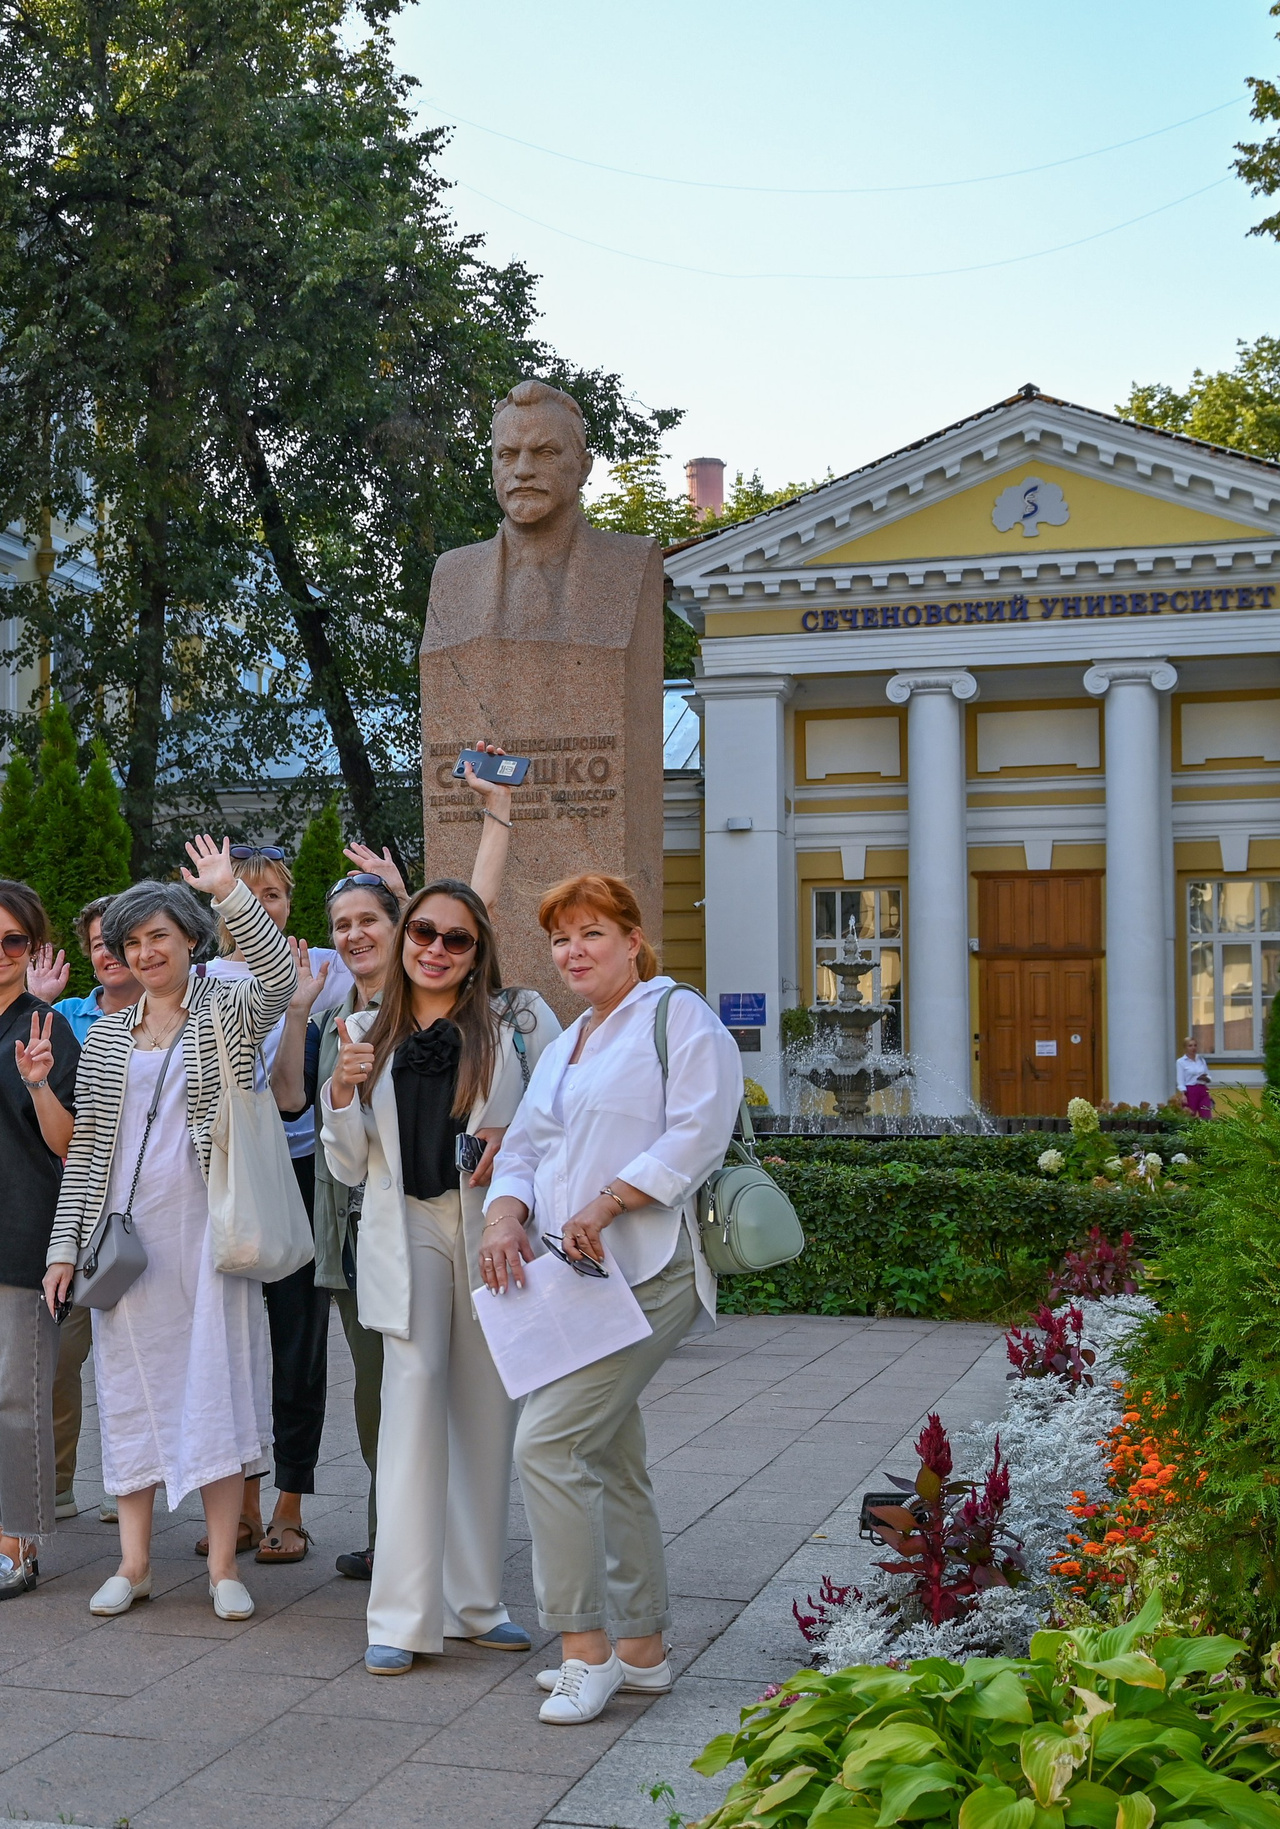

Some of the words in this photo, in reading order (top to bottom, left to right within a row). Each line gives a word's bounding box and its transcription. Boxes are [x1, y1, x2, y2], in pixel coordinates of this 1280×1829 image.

[802, 595, 1029, 631] СЕЧЕНОВСКИЙ
[1040, 586, 1275, 618] УНИВЕРСИТЕТ
[436, 755, 609, 789] СШКО
